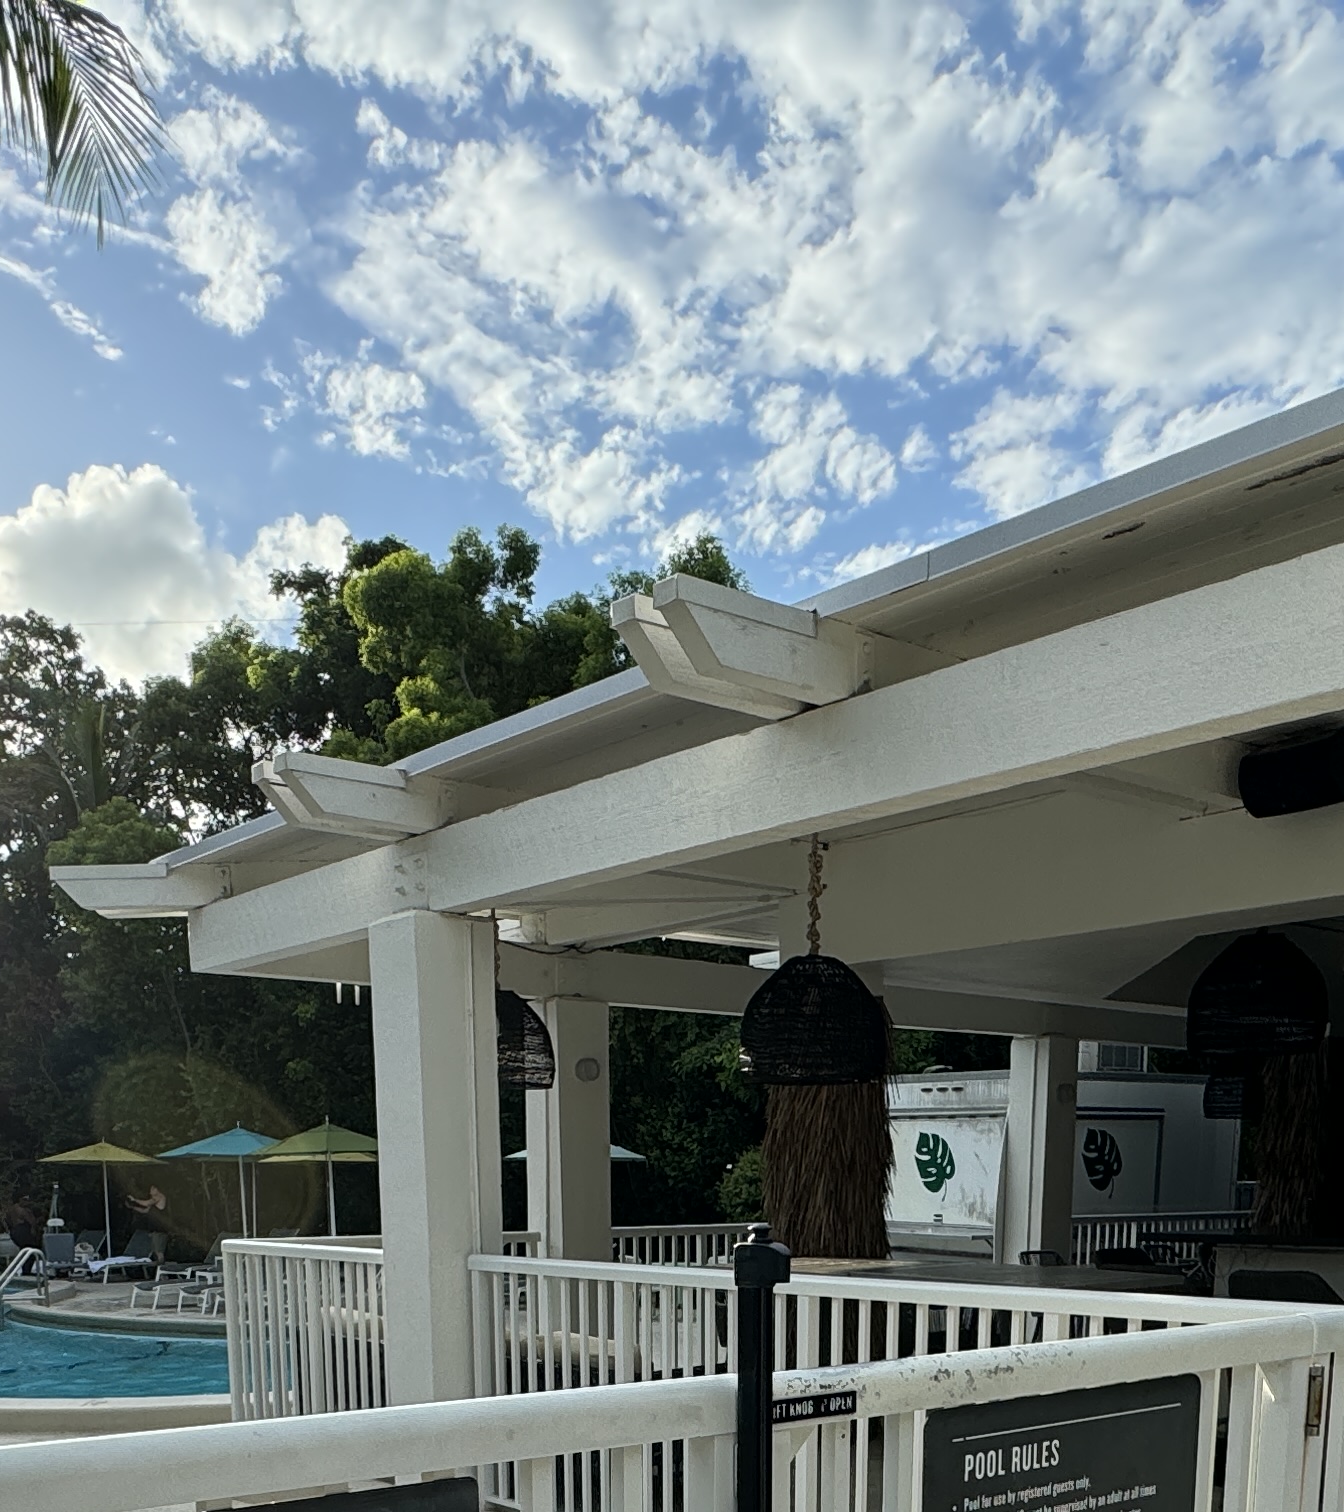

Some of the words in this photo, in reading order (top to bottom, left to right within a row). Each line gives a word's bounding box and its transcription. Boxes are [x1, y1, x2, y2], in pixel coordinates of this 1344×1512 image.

[830, 1396, 852, 1411] OPEN
[964, 1449, 1005, 1482] POOL
[1011, 1440, 1060, 1474] RULES
[964, 1495, 980, 1512] Pool
[982, 1494, 991, 1508] for
[993, 1494, 1006, 1505] use
[1007, 1490, 1016, 1505] by
